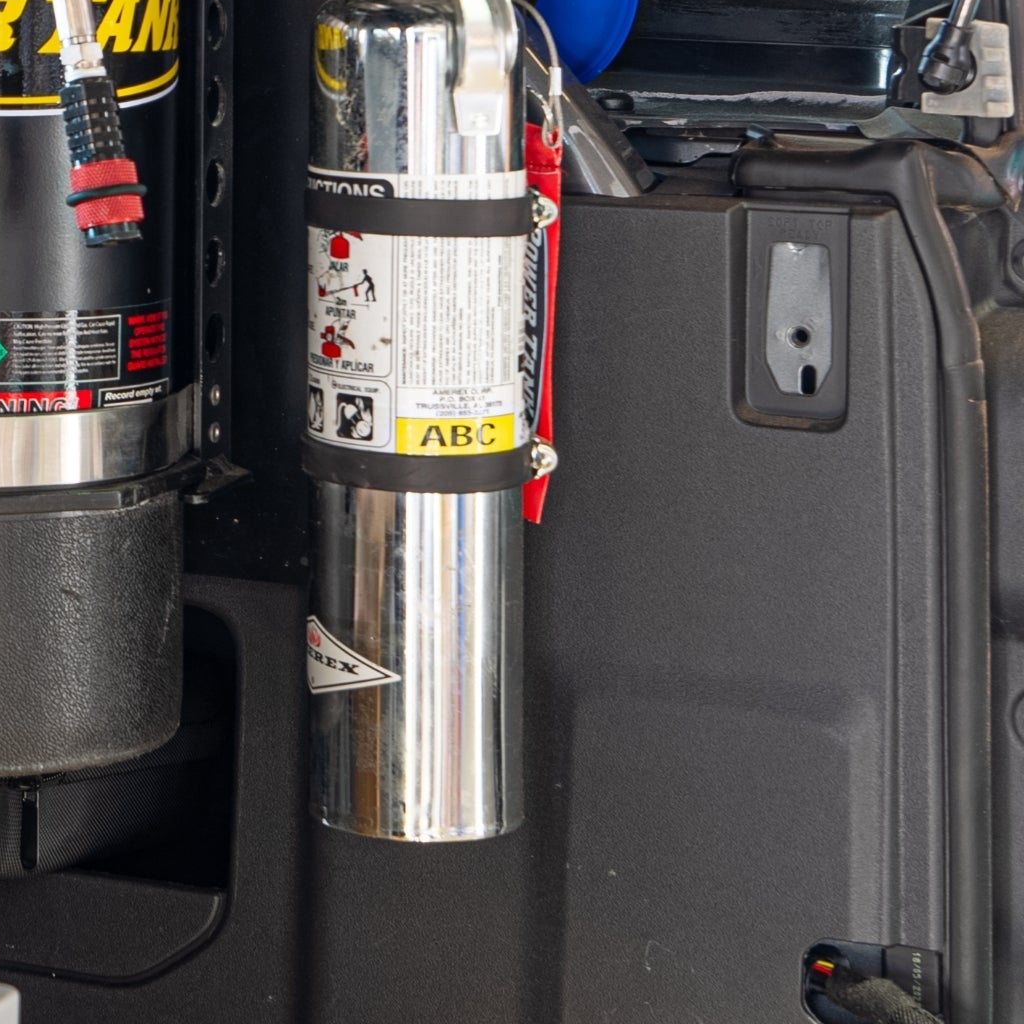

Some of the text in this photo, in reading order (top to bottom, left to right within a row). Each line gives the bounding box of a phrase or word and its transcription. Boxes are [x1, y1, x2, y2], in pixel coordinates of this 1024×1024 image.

[523, 230, 542, 323] POWER
[104, 387, 135, 401] Record
[420, 423, 496, 447] ABC
